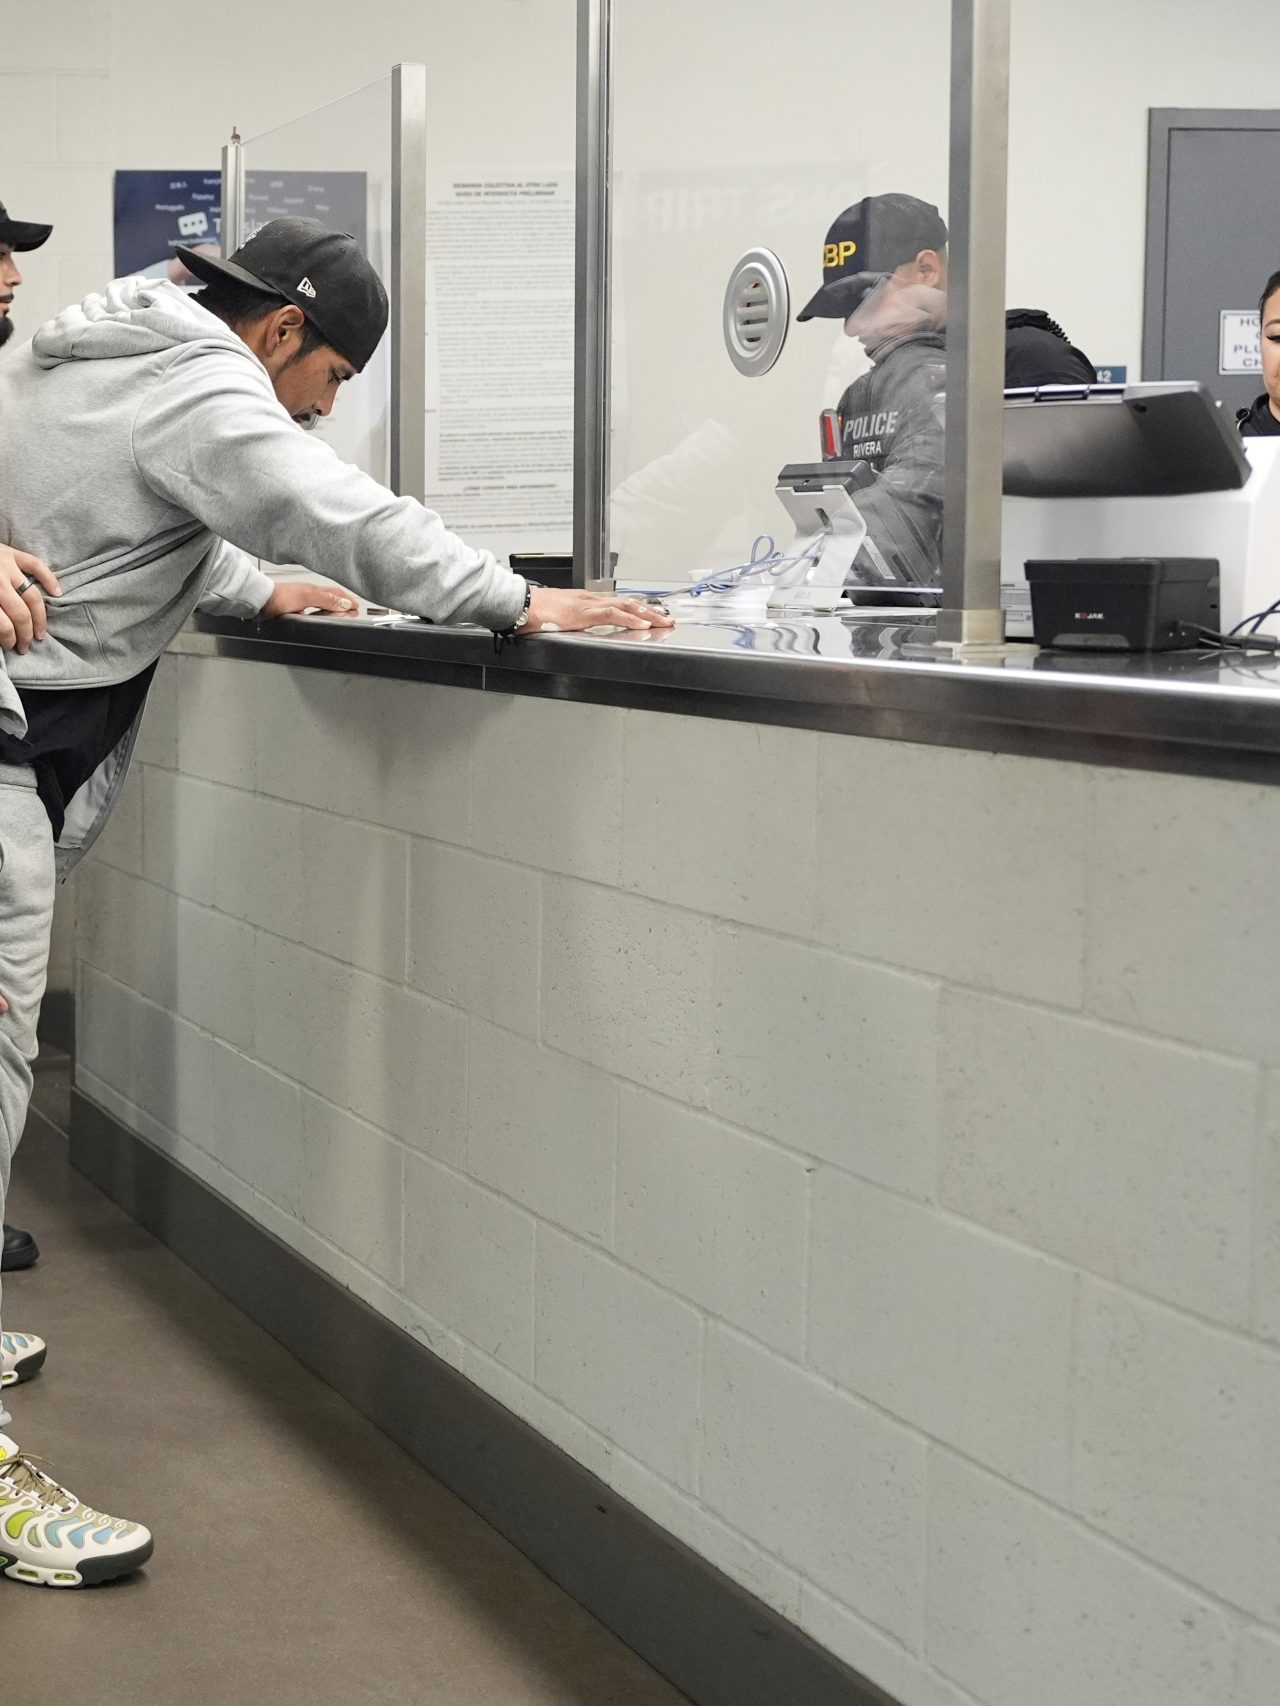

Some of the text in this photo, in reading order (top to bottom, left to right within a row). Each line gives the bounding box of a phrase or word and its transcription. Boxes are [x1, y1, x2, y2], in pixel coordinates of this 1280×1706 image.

[822, 240, 857, 269] BP
[843, 411, 898, 442] POLICE
[853, 440, 882, 459] RIVERA
